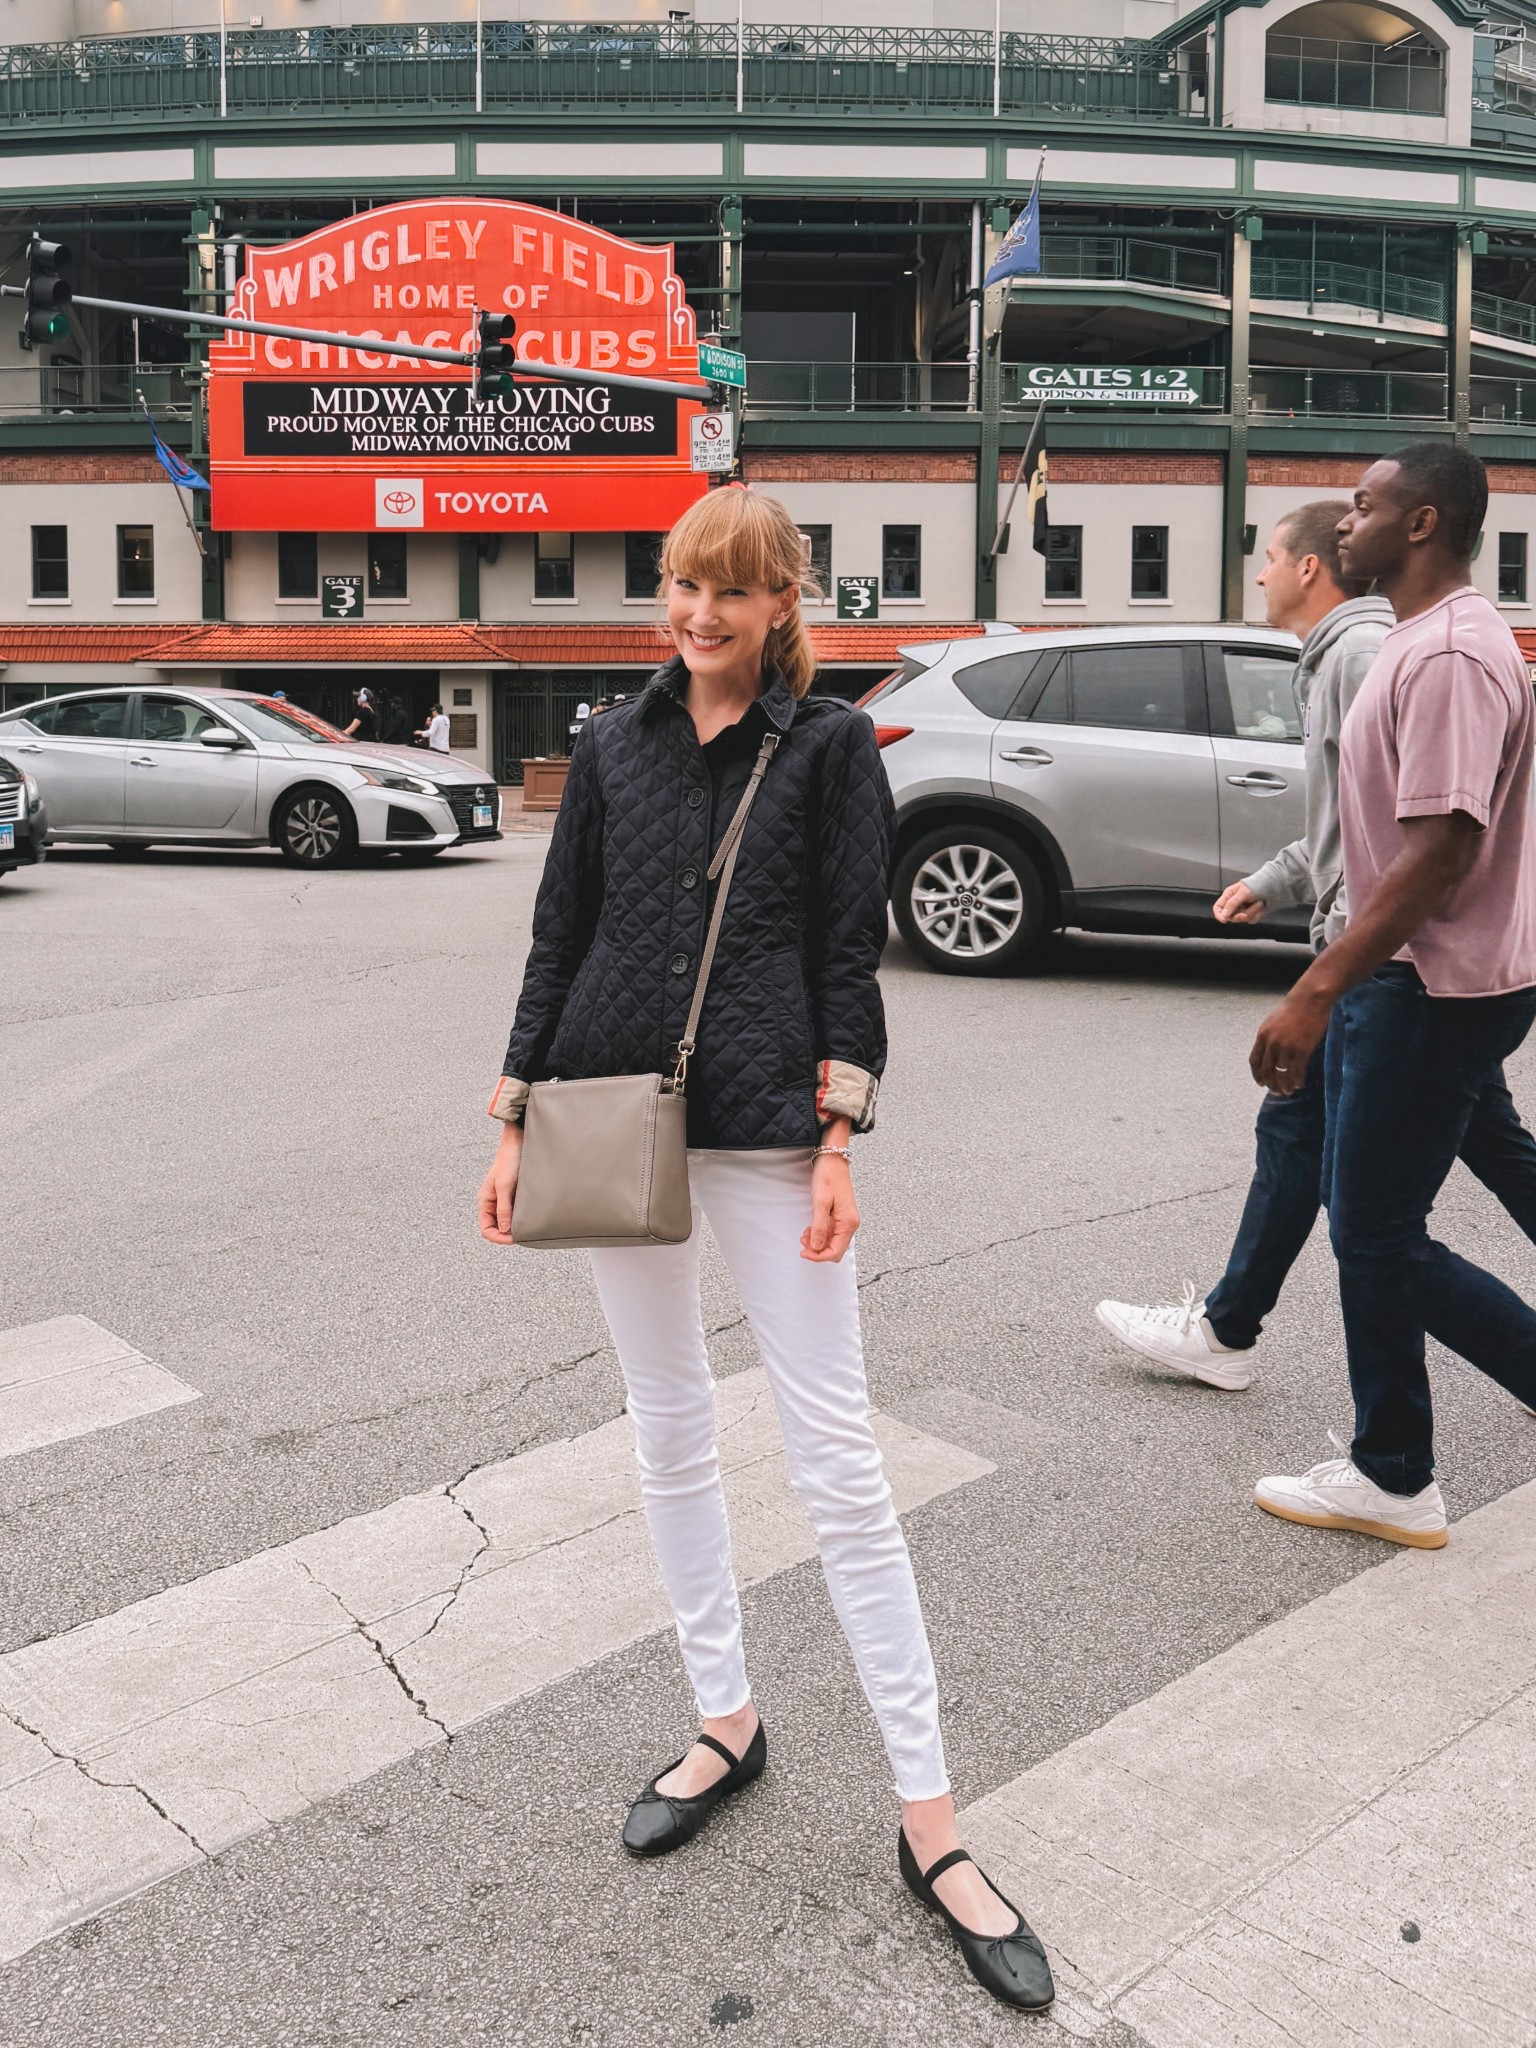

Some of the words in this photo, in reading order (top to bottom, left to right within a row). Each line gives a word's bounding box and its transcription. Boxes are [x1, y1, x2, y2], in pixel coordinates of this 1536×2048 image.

[263, 219, 487, 309] WRIGLEY
[512, 223, 655, 306] FIELD
[373, 284, 476, 309] HOME
[502, 284, 550, 309] OF
[516, 330, 657, 369] CUBS
[706, 349, 737, 370] ADDISON
[1028, 367, 1132, 387] GATES
[310, 387, 457, 414] MIDWAY
[465, 387, 611, 414] MOVING
[1028, 389, 1095, 399] ADDISON
[1100, 390, 1111, 399] &
[1115, 390, 1190, 401] SHEFFIELD
[267, 416, 338, 433] PROUD
[344, 416, 419, 433] MOVER
[423, 416, 450, 433] OF
[455, 416, 495, 433] THE
[500, 416, 596, 433] CHICAGO
[600, 415, 655, 433] CUBS
[351, 434, 571, 451] MIDWAYMOVING.COM
[434, 492, 549, 514] TOYOTA
[325, 577, 361, 586] GATE
[840, 578, 877, 587] GATE
[330, 585, 356, 609] 3
[844, 586, 871, 610] 3
